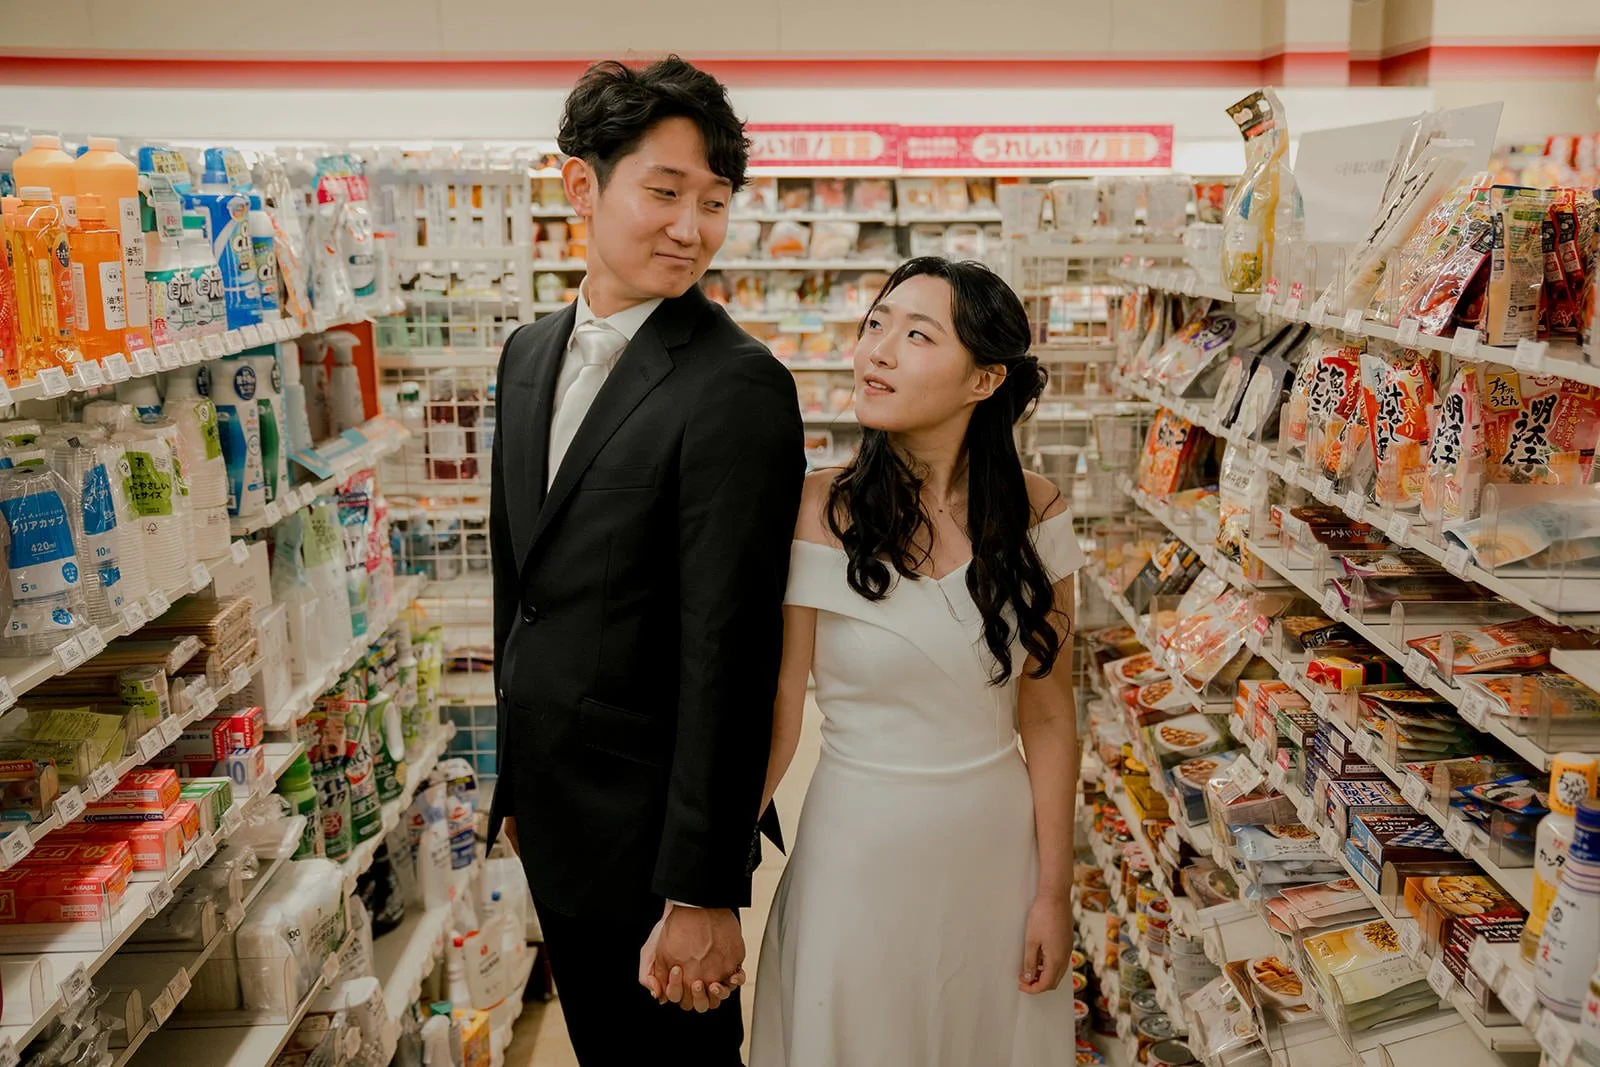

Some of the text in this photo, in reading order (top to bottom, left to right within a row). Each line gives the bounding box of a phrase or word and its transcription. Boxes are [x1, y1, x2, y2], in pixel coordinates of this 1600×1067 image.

[1488, 376, 1515, 396] プチッと
[1490, 395, 1520, 408] うどん
[1516, 394, 1558, 470] 明太子
